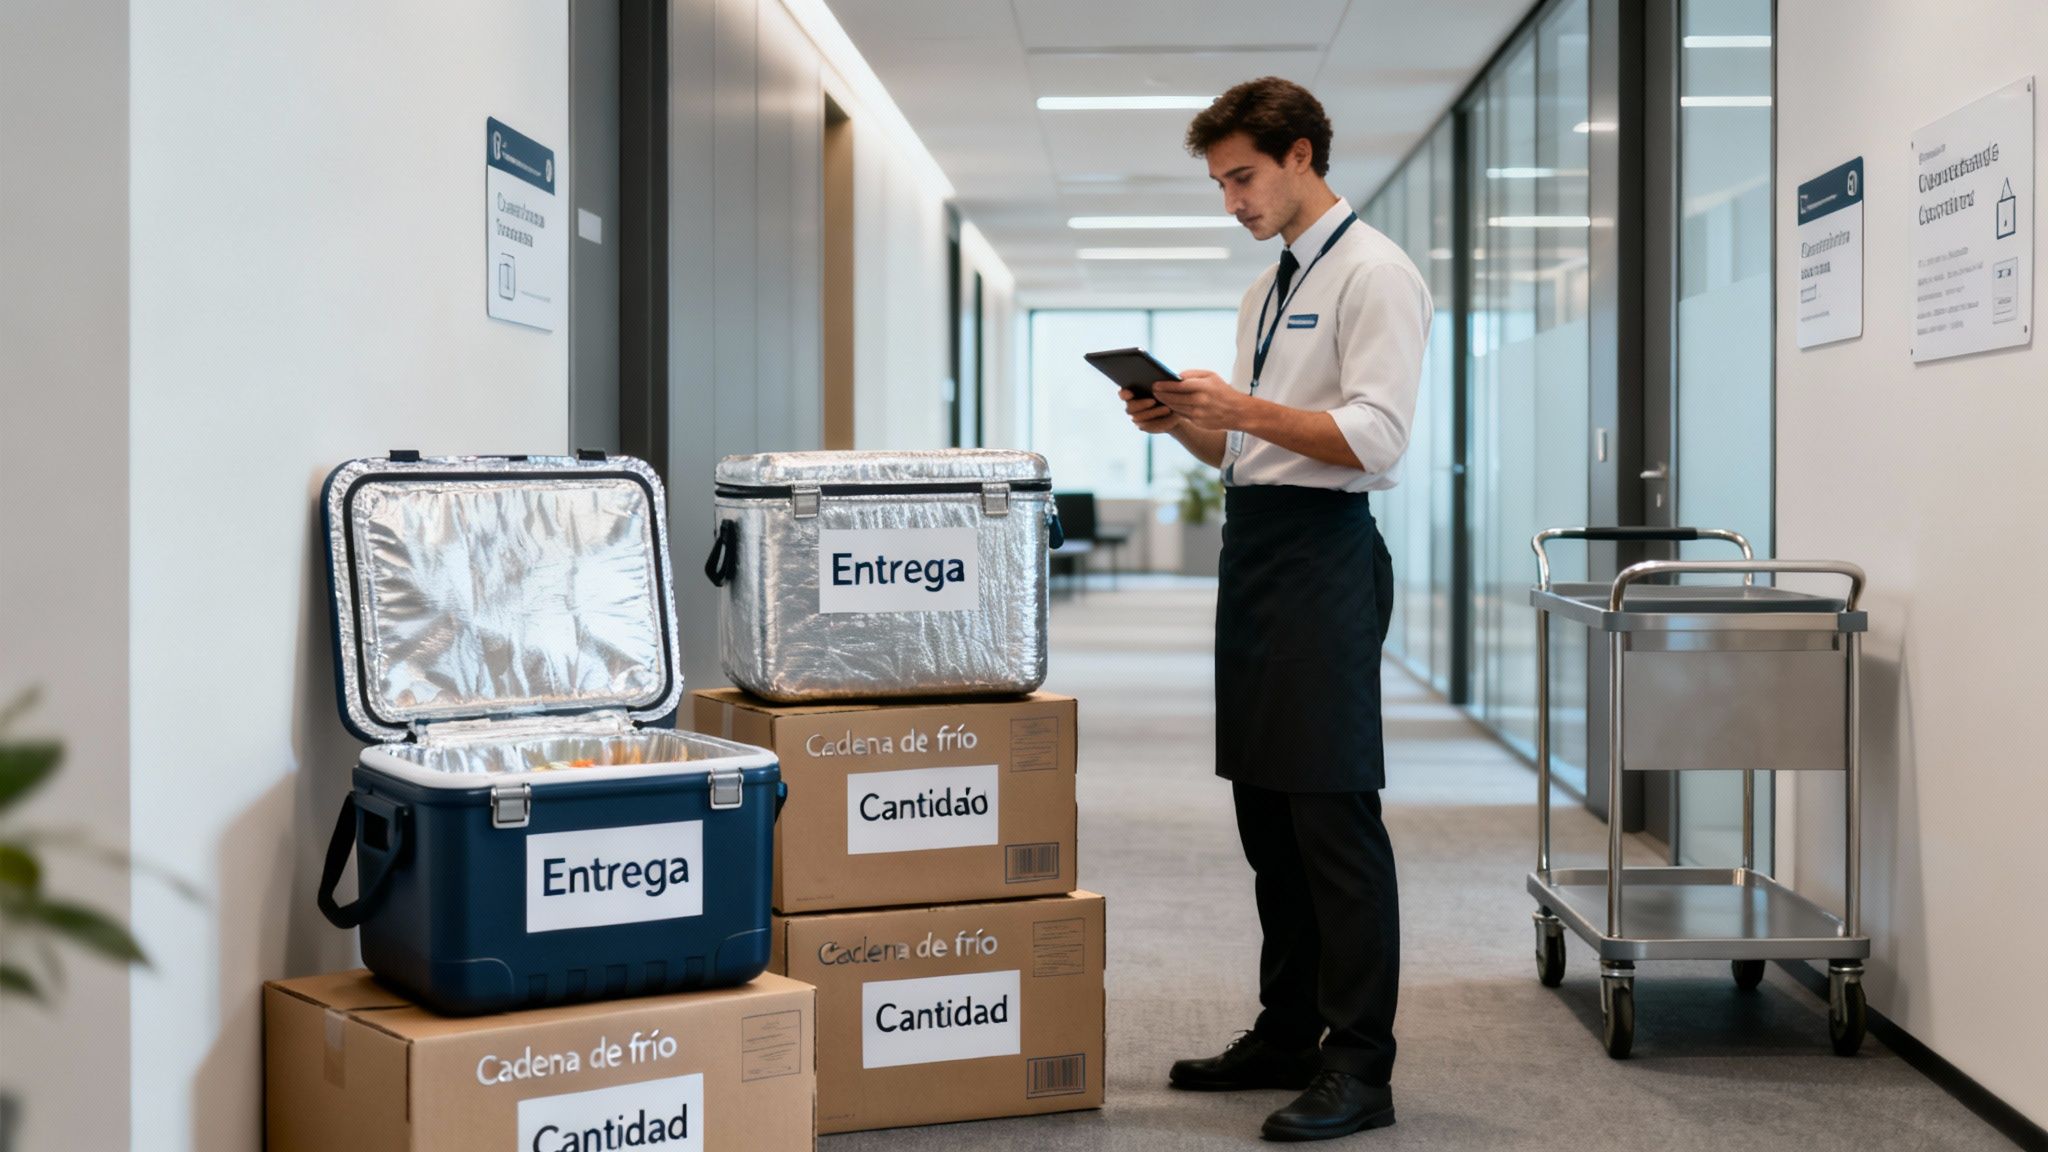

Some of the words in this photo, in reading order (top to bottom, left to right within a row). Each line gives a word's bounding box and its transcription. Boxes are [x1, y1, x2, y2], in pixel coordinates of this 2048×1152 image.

[832, 552, 966, 593] Entrega
[900, 728, 928, 753] de
[937, 723, 978, 752] frío
[543, 857, 690, 898] Entrega
[916, 931, 948, 959] de
[955, 928, 999, 957] frío
[875, 994, 1009, 1033] Cantidad
[476, 1046, 581, 1086] Cadena
[589, 1036, 623, 1069] de
[629, 1029, 678, 1066] frío
[532, 1103, 689, 1152] Cantidad
